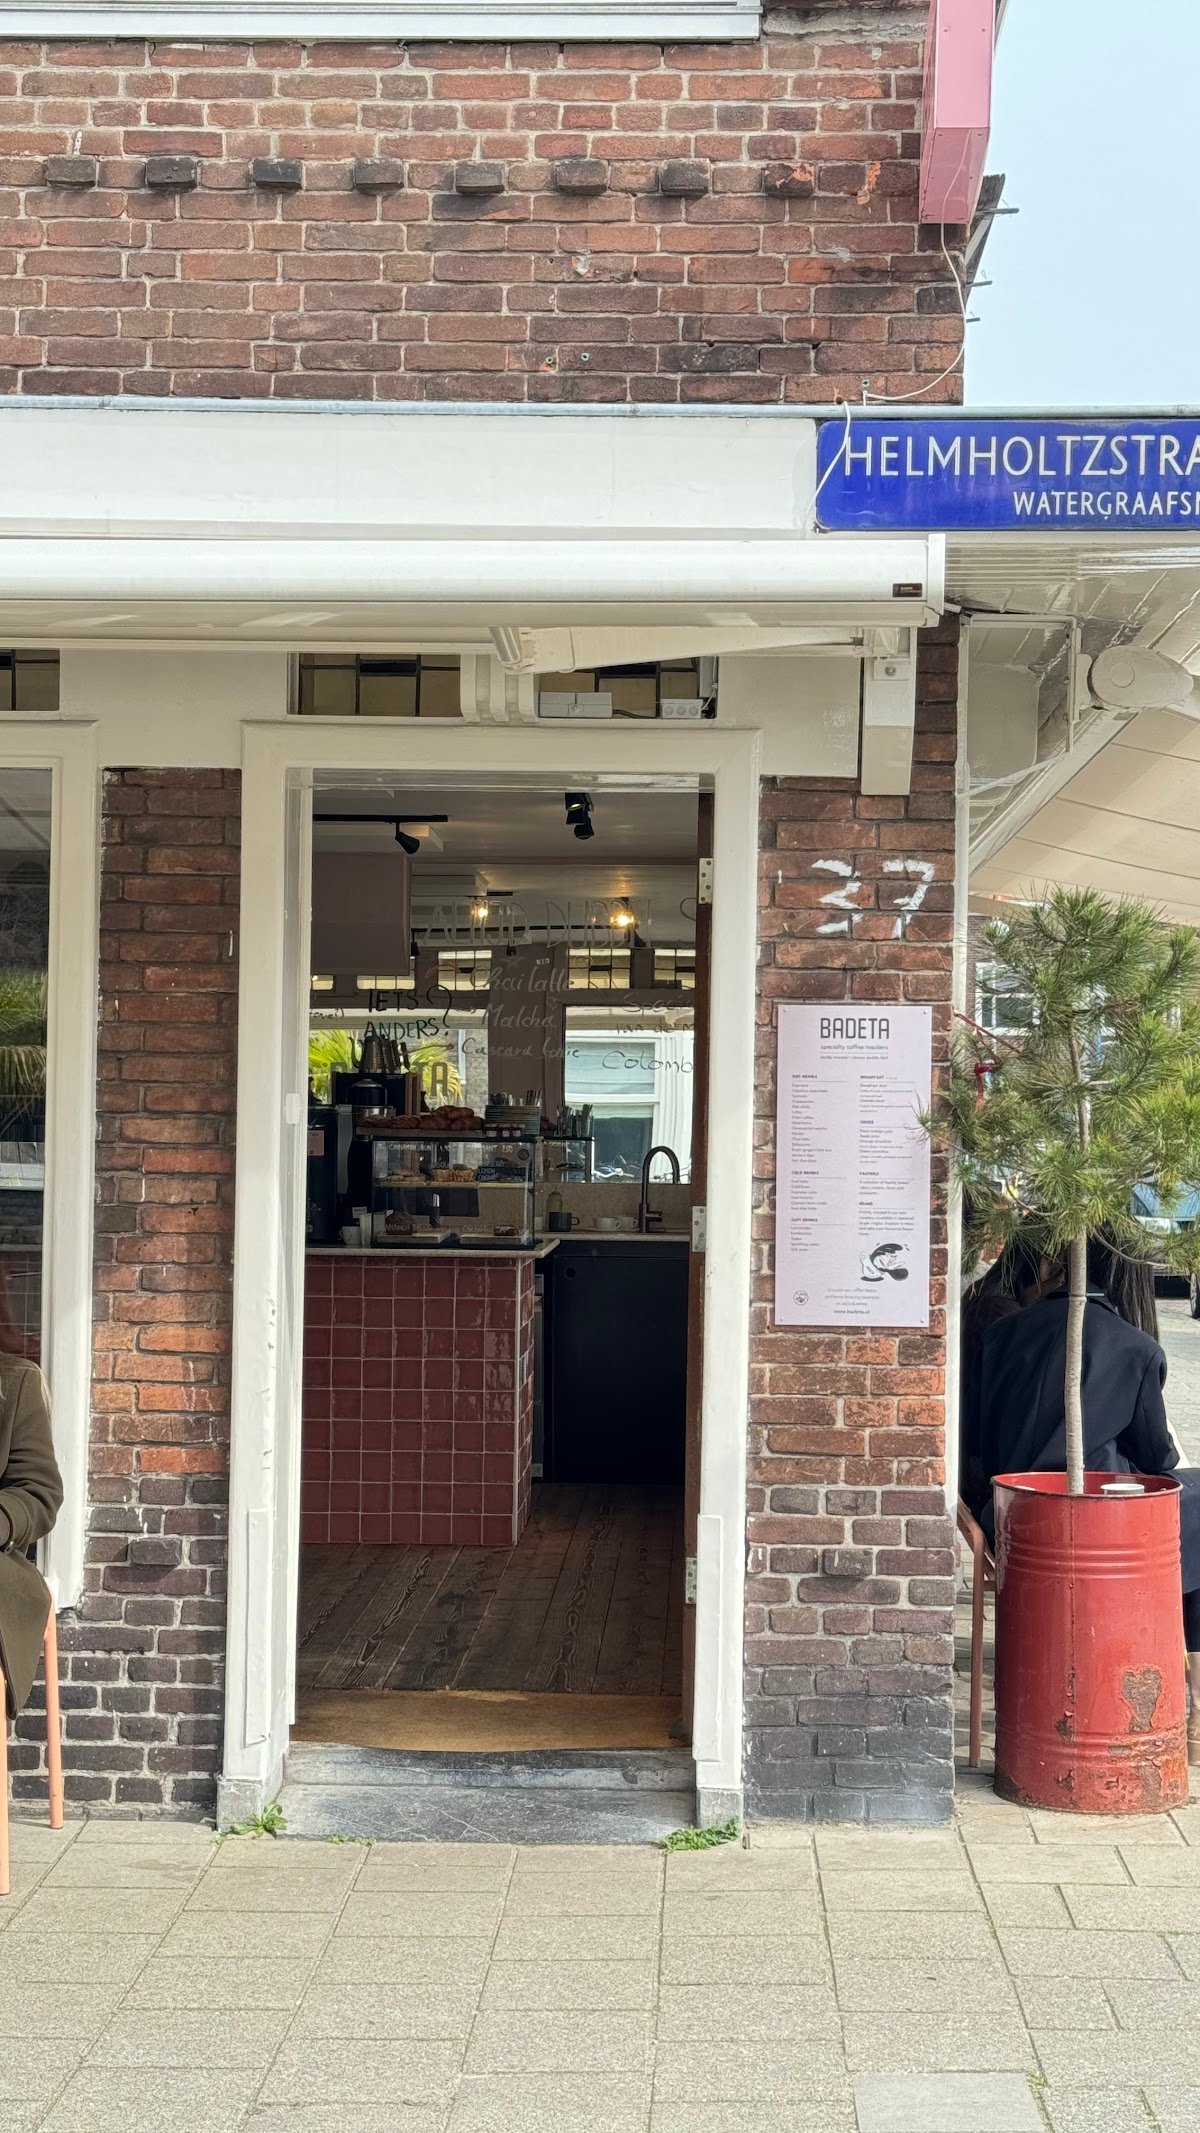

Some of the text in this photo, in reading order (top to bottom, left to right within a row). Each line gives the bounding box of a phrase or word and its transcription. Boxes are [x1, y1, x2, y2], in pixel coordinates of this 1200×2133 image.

[1013, 490, 1200, 517] WATERGRAAFS
[811, 859, 935, 939] 37
[368, 988, 418, 1013] IETS
[821, 1018, 889, 1039] BADETA
